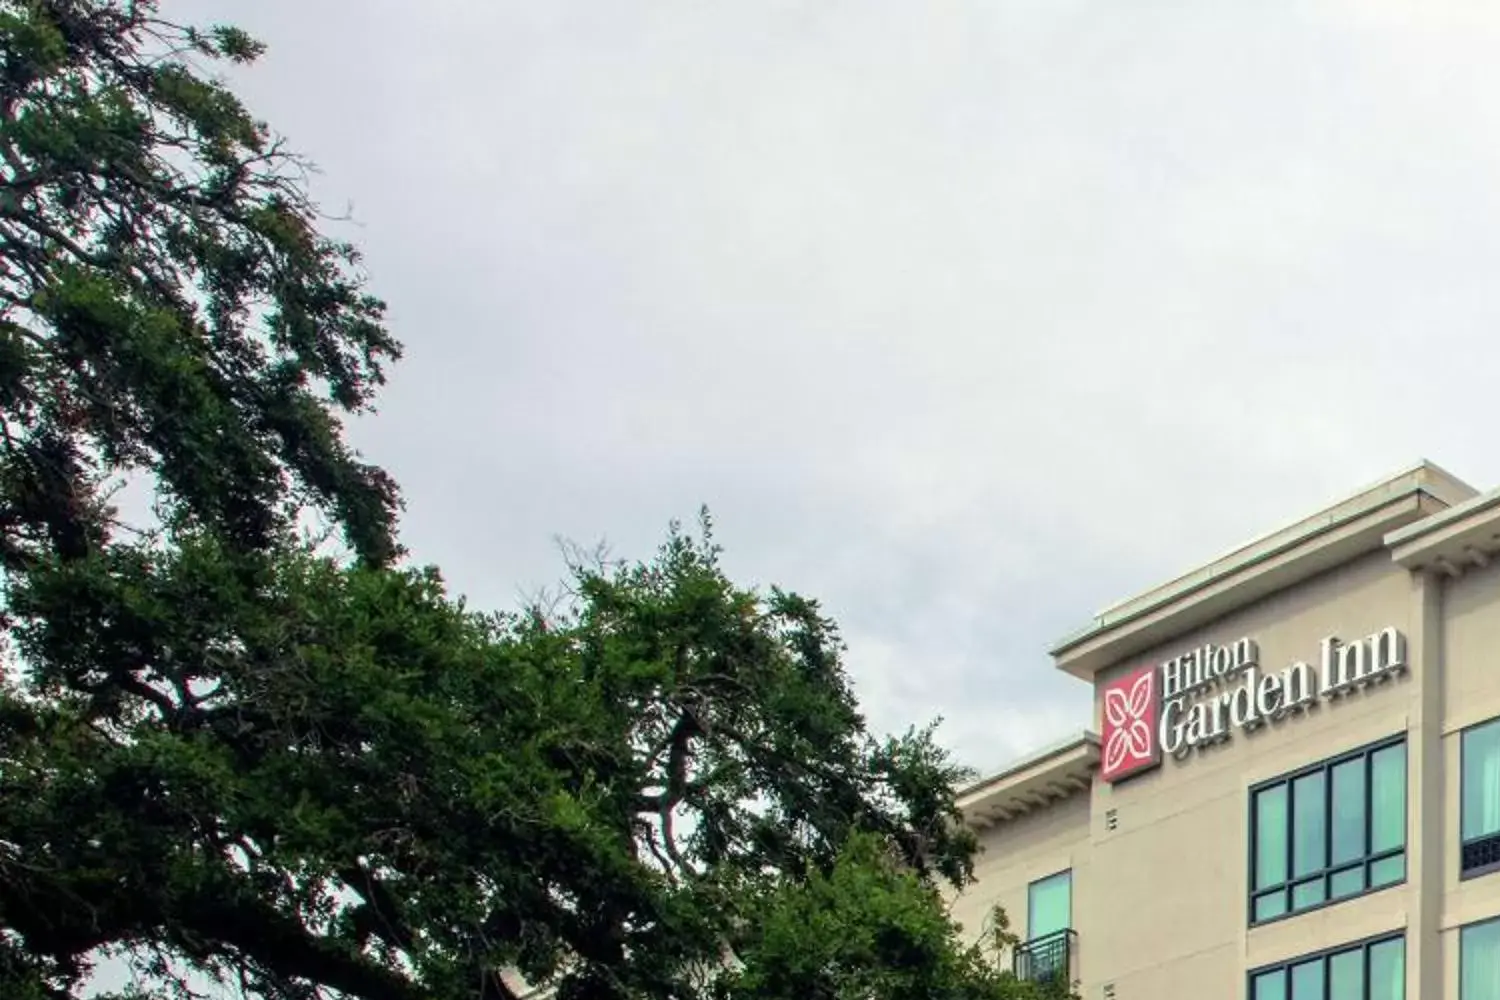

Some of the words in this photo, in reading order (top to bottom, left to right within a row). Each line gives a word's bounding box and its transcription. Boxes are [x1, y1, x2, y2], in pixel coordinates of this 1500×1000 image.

[1159, 661, 1310, 753] Garden
[1320, 626, 1402, 695] Inn
[1162, 637, 1252, 698] Hilton
